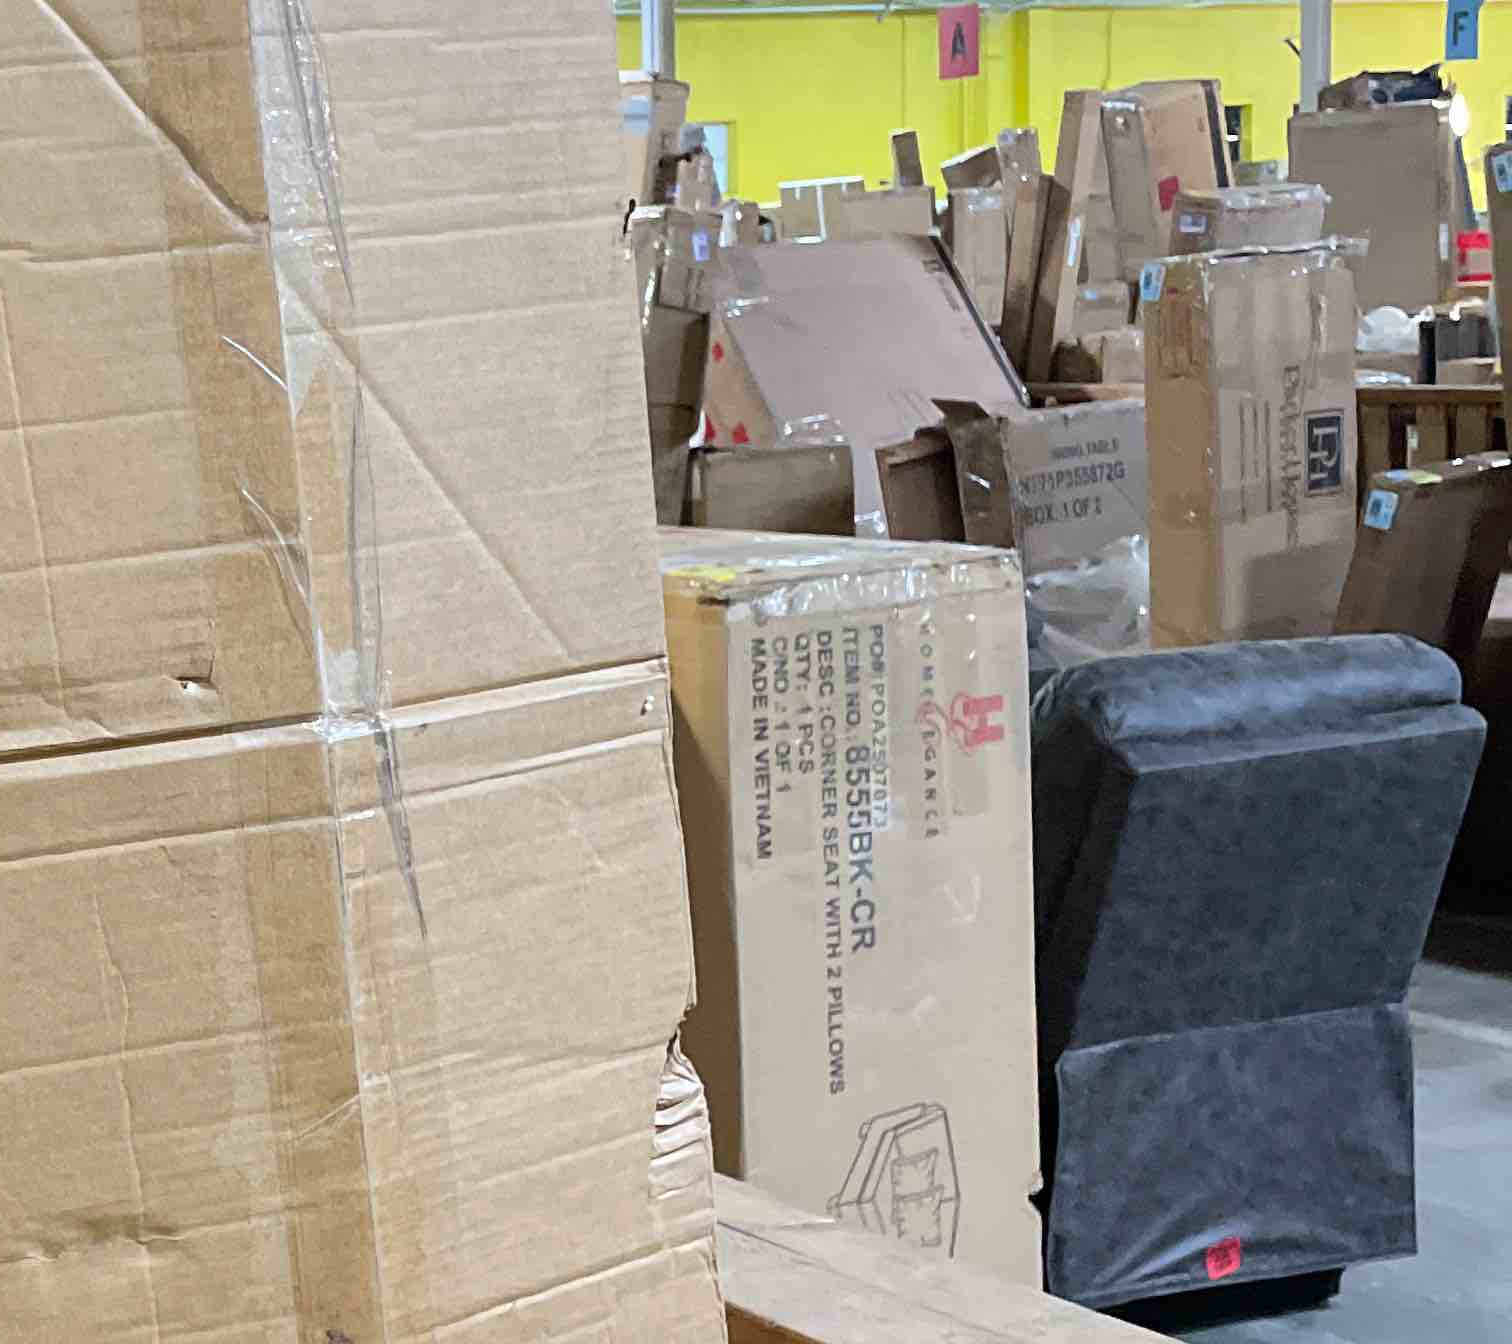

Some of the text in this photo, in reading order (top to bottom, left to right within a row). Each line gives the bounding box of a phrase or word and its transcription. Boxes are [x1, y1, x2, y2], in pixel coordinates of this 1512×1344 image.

[949, 20, 969, 63] A
[1451, 10, 1470, 47] F
[816, 630, 835, 697] DESC
[751, 637, 773, 860] MADE IN VIETNAM
[774, 741, 791, 774] OF
[797, 724, 814, 774] PCS
[823, 824, 840, 889] SEAT
[844, 744, 875, 953] 8555BK-CR
[825, 898, 842, 960] WITH
[827, 966, 843, 978] 2
[828, 985, 844, 1095] PILLOWS
